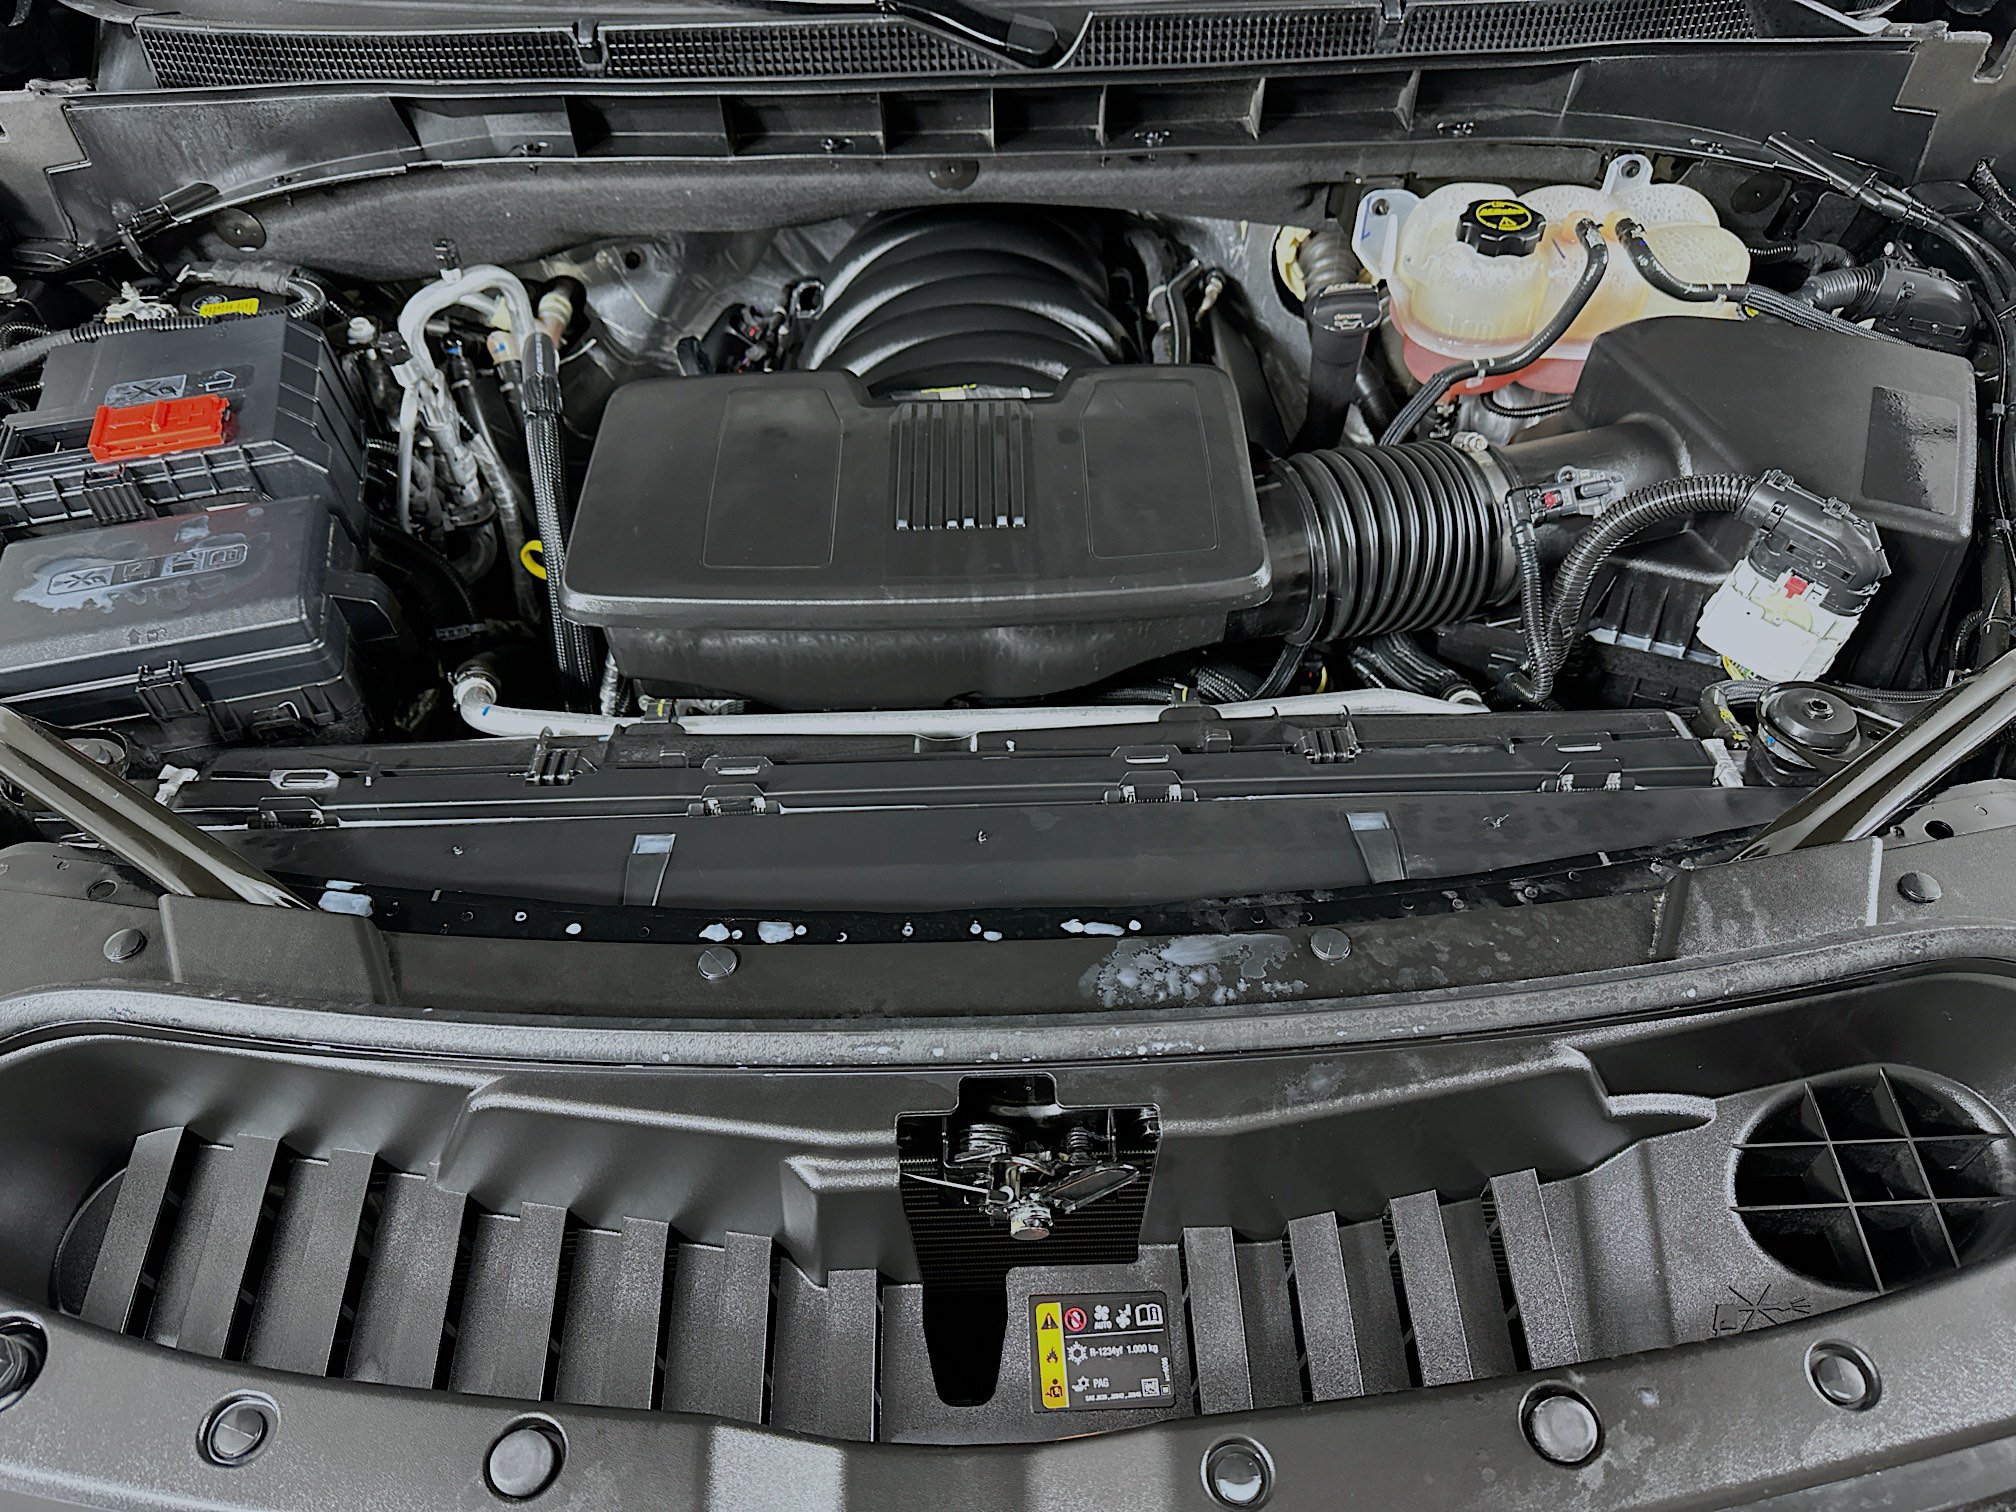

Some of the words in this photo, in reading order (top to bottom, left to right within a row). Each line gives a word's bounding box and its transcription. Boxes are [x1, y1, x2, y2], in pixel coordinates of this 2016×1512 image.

[1094, 1321, 1112, 1330] AUTO
[1089, 1346, 1123, 1357] R-1234yf
[1126, 1344, 1147, 1353] 1.000
[1148, 1343, 1159, 1354] kg
[1093, 1378, 1109, 1388] PAG
